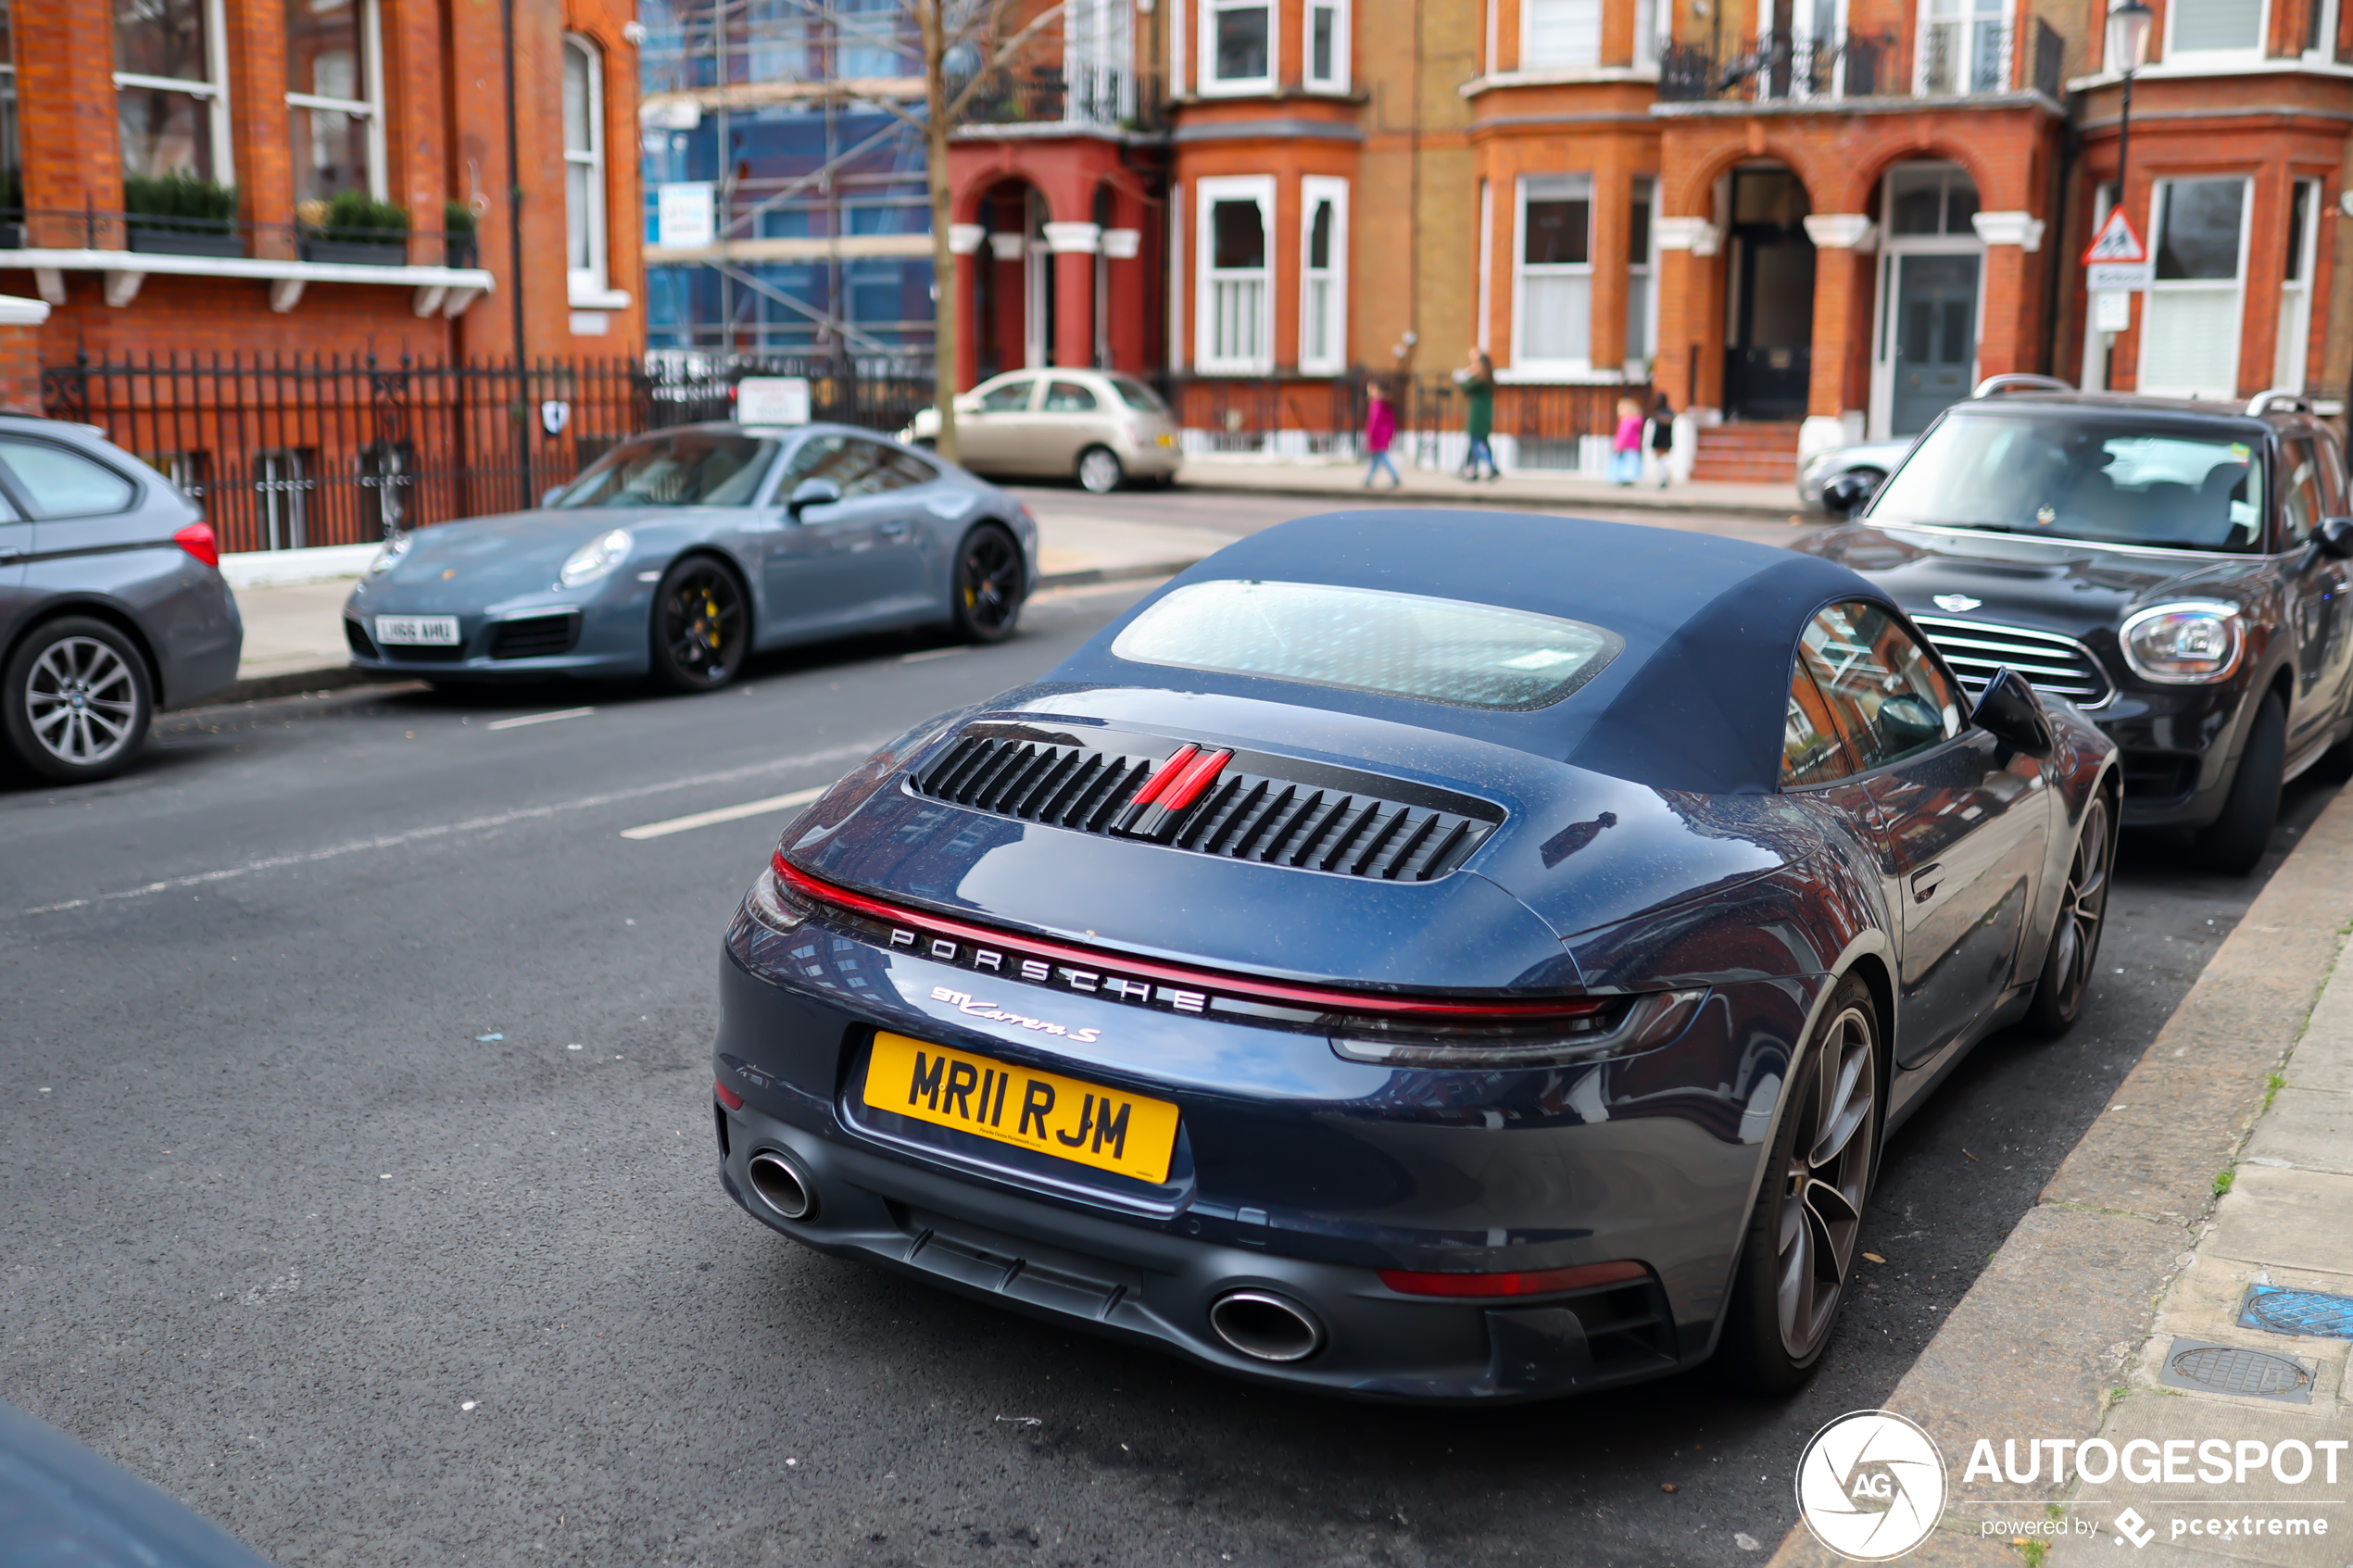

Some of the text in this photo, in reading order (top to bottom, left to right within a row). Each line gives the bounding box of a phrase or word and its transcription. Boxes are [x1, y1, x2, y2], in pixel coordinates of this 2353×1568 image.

[889, 928, 1206, 1013] PORSCHE
[958, 1001, 1067, 1036] Carrera
[1067, 1028, 1101, 1043] S
[908, 1051, 1131, 1160] MR11 RJM
[979, 1127, 1030, 1145] Porsche Centre Portsmouth
